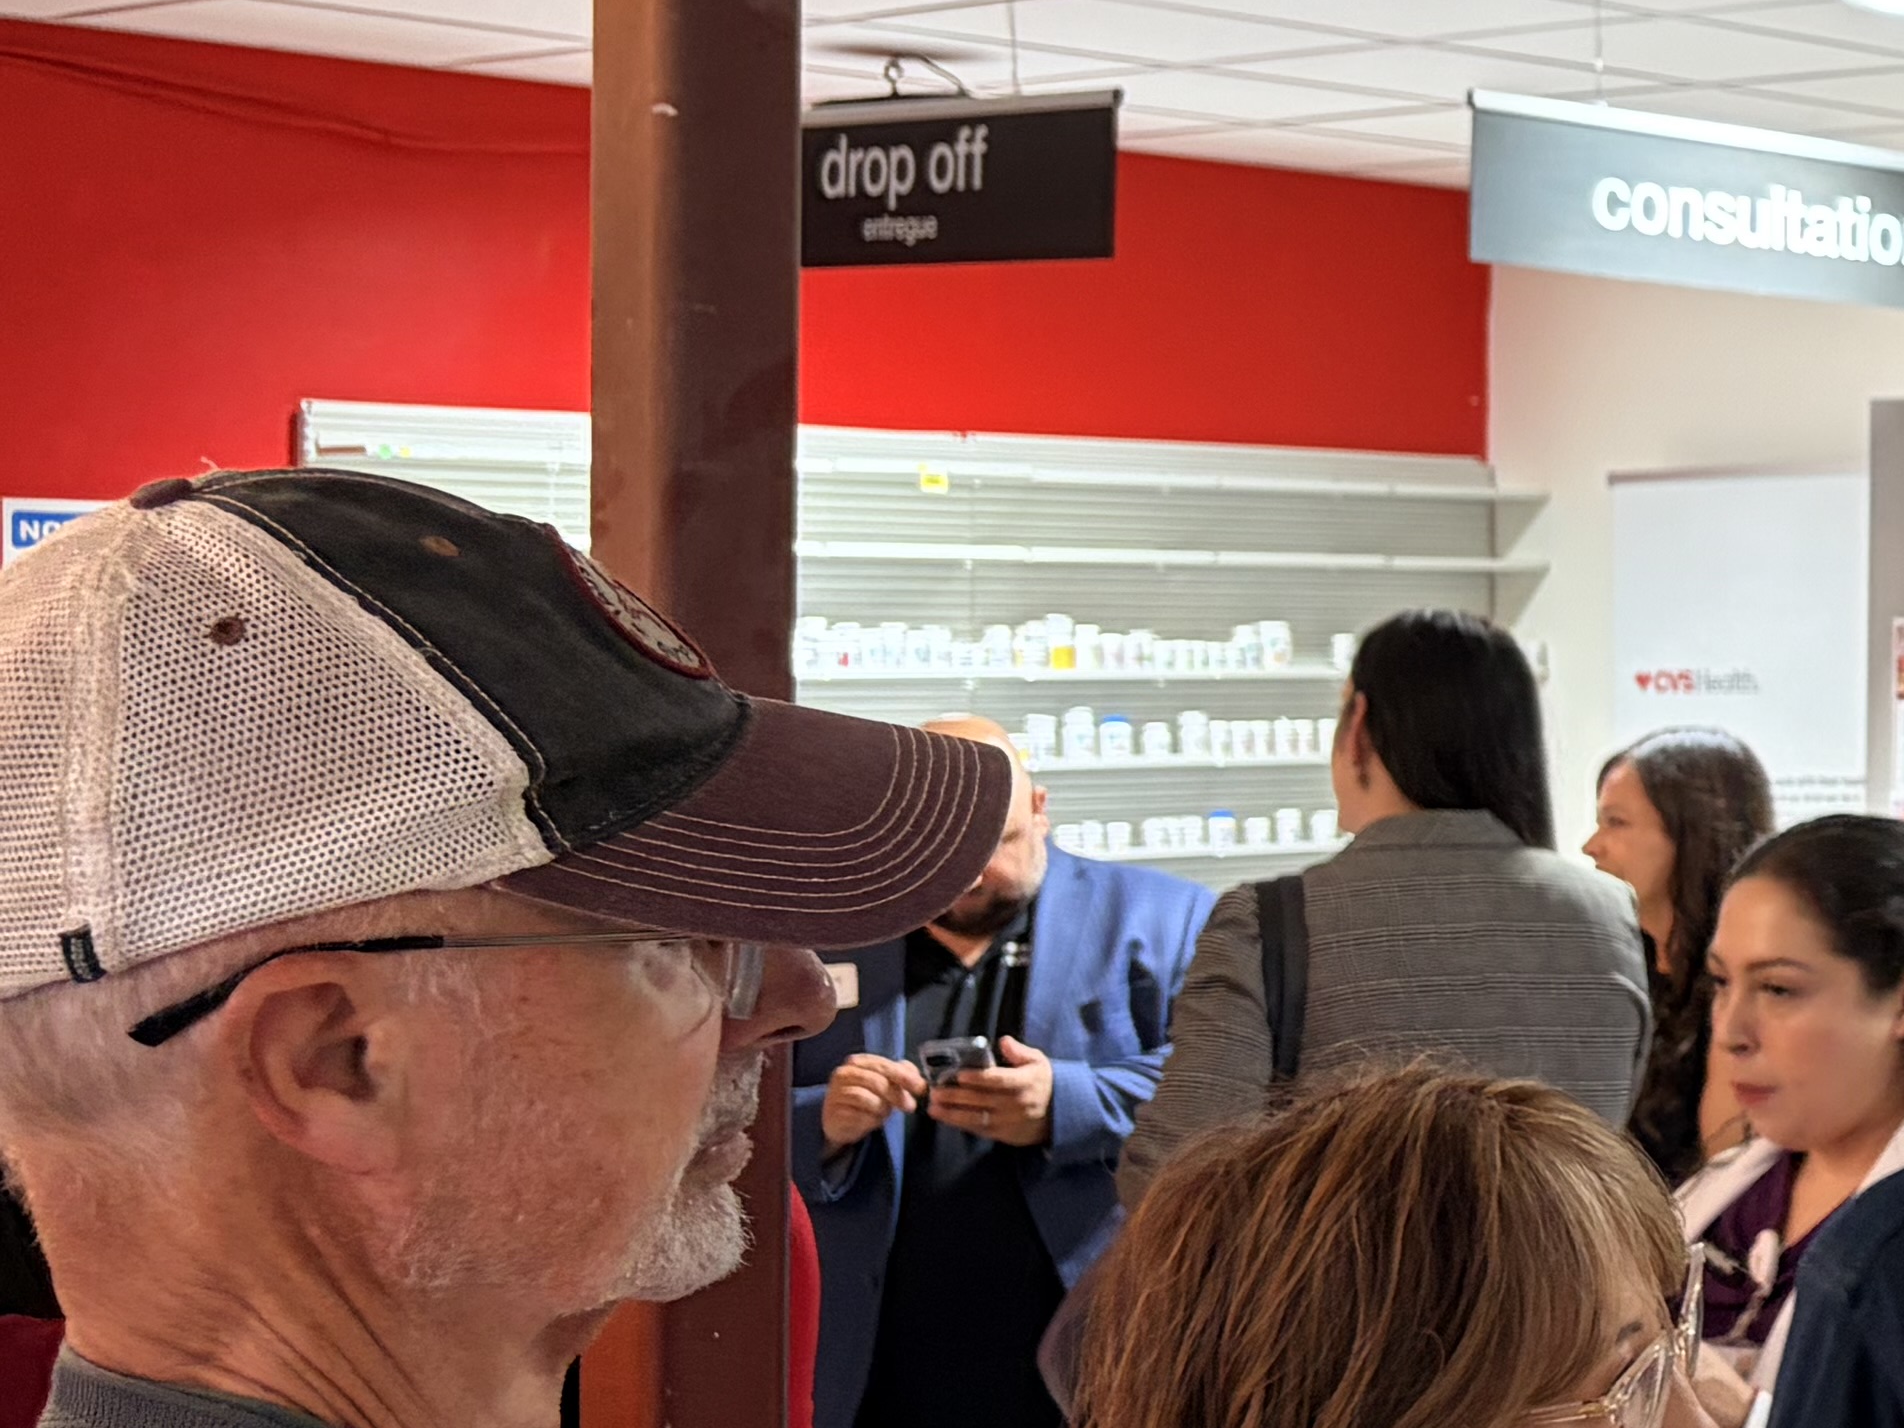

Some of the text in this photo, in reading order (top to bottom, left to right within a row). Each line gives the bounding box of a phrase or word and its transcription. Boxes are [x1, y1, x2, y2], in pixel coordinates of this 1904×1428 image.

[820, 123, 989, 211] drop off
[1653, 668, 1694, 694] CVS
